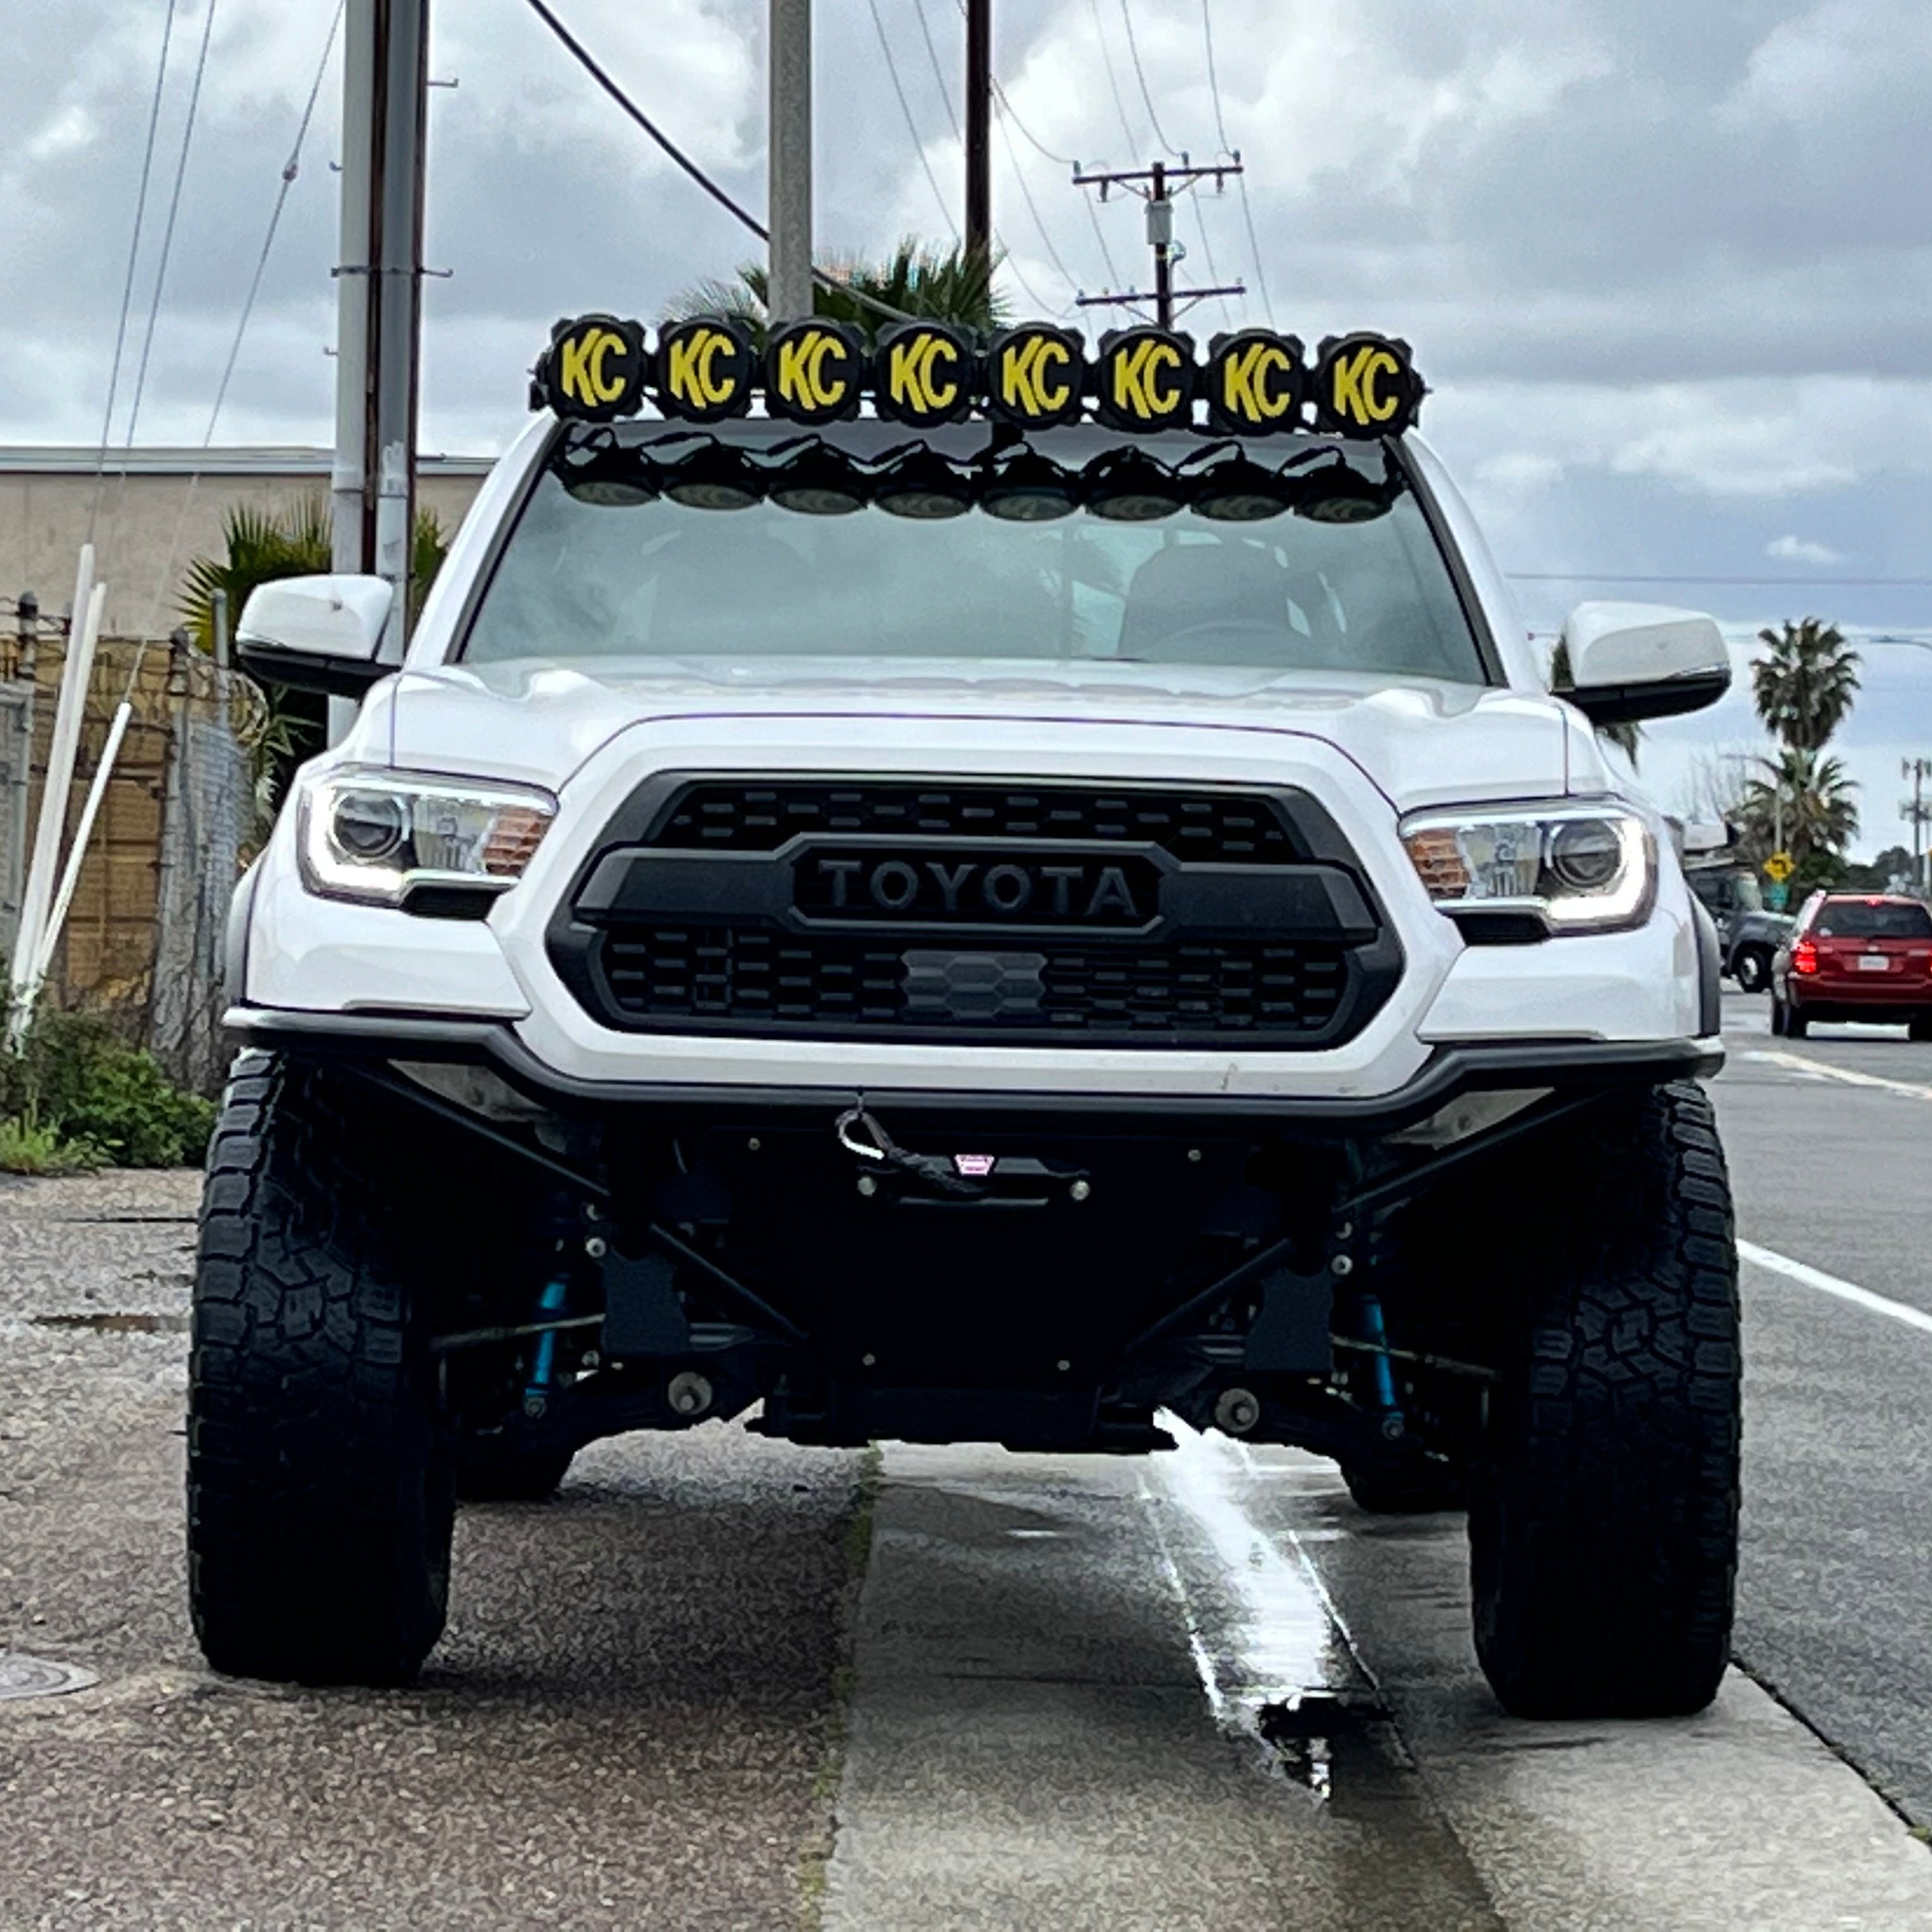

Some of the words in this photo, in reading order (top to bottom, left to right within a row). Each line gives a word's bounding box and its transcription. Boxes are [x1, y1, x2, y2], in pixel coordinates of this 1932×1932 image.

[563, 329, 625, 407] KC
[671, 330, 735, 408] KC
[779, 332, 846, 408] KC
[891, 335, 956, 413] KC
[1004, 337, 1070, 416] KC
[1115, 340, 1179, 417] KC
[1225, 344, 1290, 420] KC
[1335, 348, 1399, 424] KC
[818, 860, 1137, 916] TOYOTA
